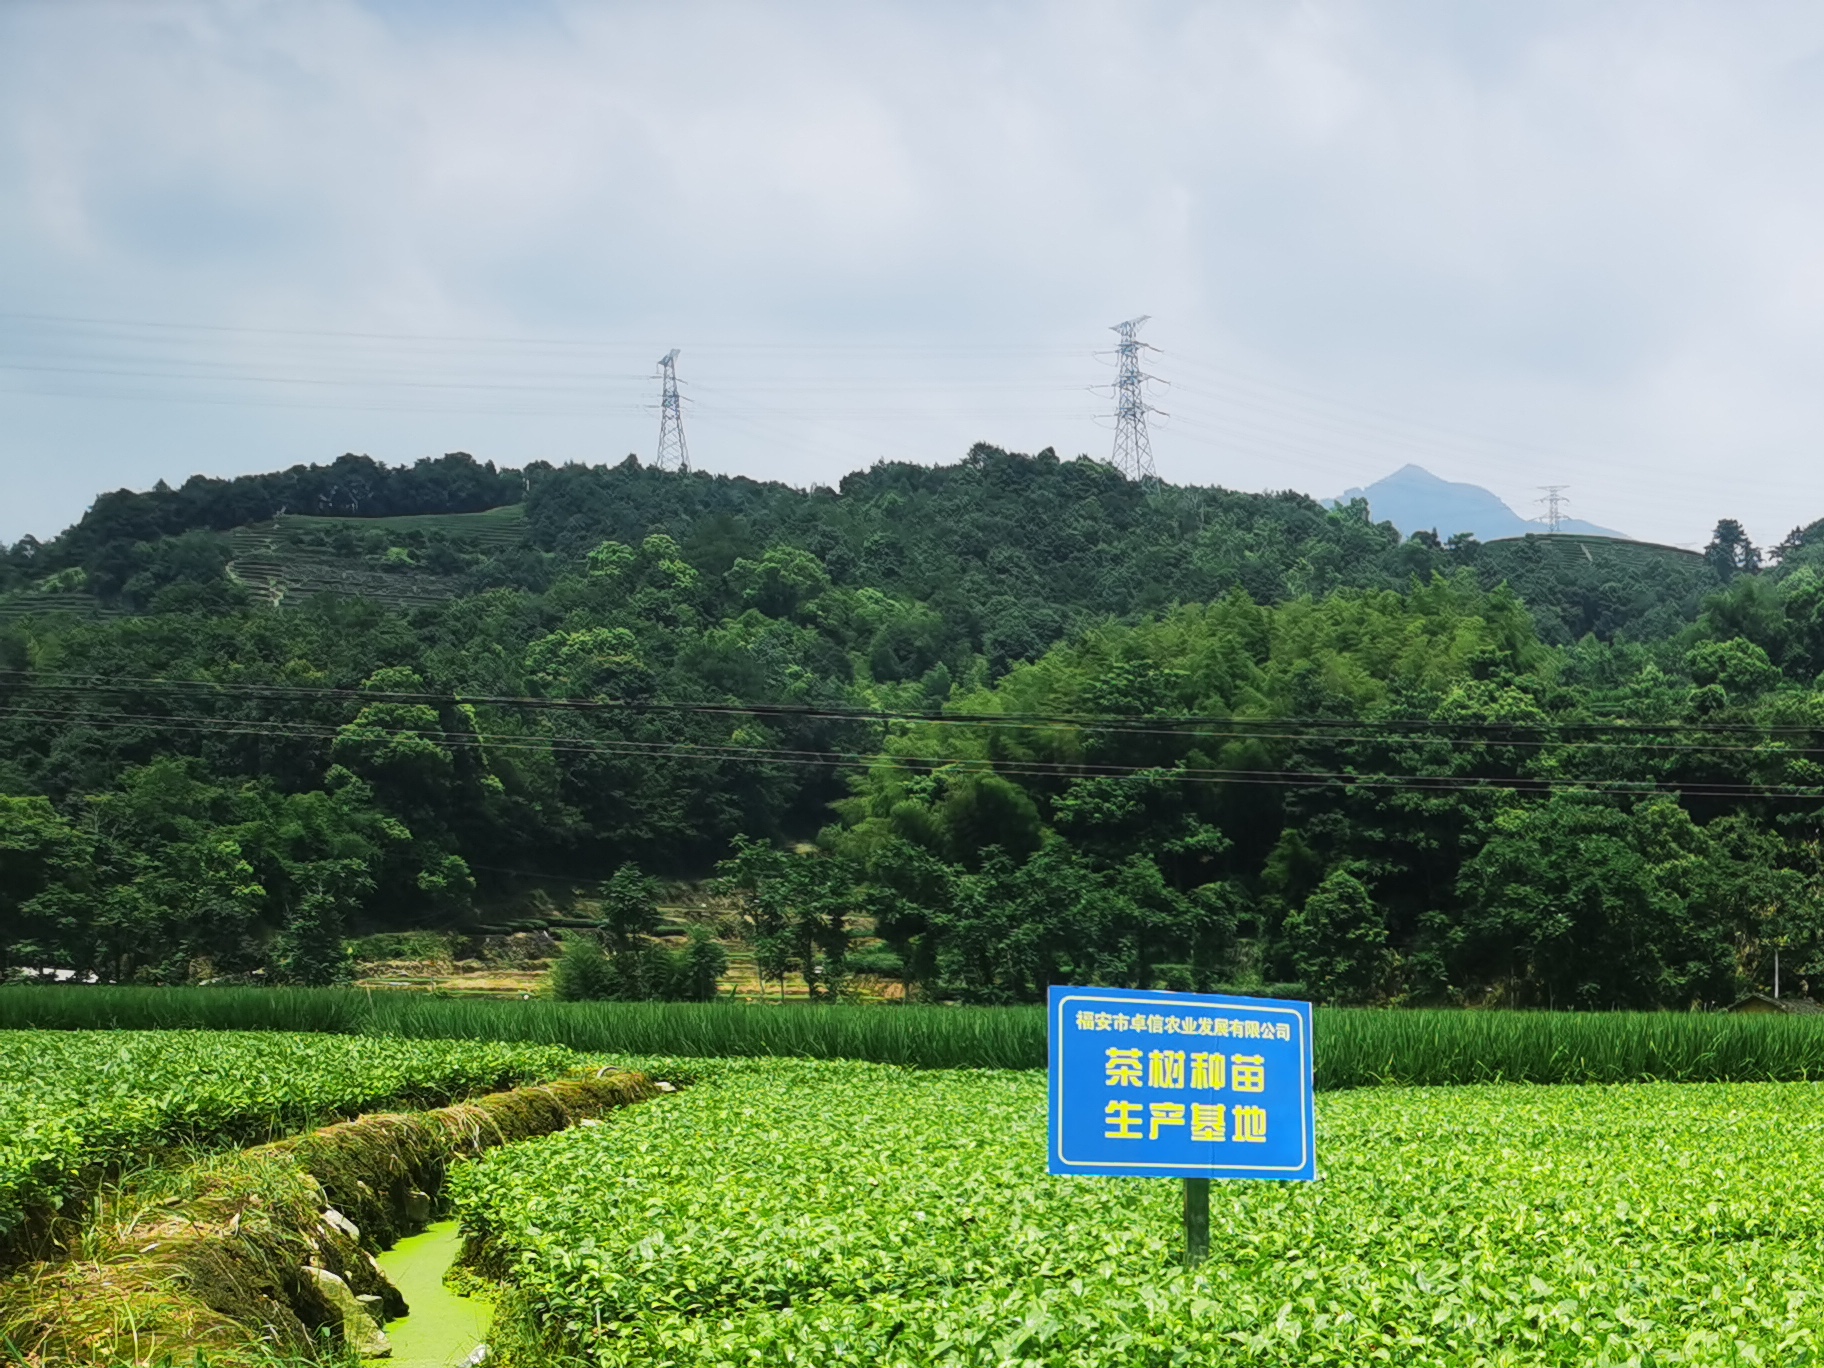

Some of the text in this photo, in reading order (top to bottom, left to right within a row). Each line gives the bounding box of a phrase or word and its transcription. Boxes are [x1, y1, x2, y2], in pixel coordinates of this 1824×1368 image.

[1076, 1010, 1291, 1041] 福安市卓信农业发展有限公司
[1105, 1047, 1265, 1092] 茶树种苗
[1104, 1100, 1266, 1143] 生产基地
